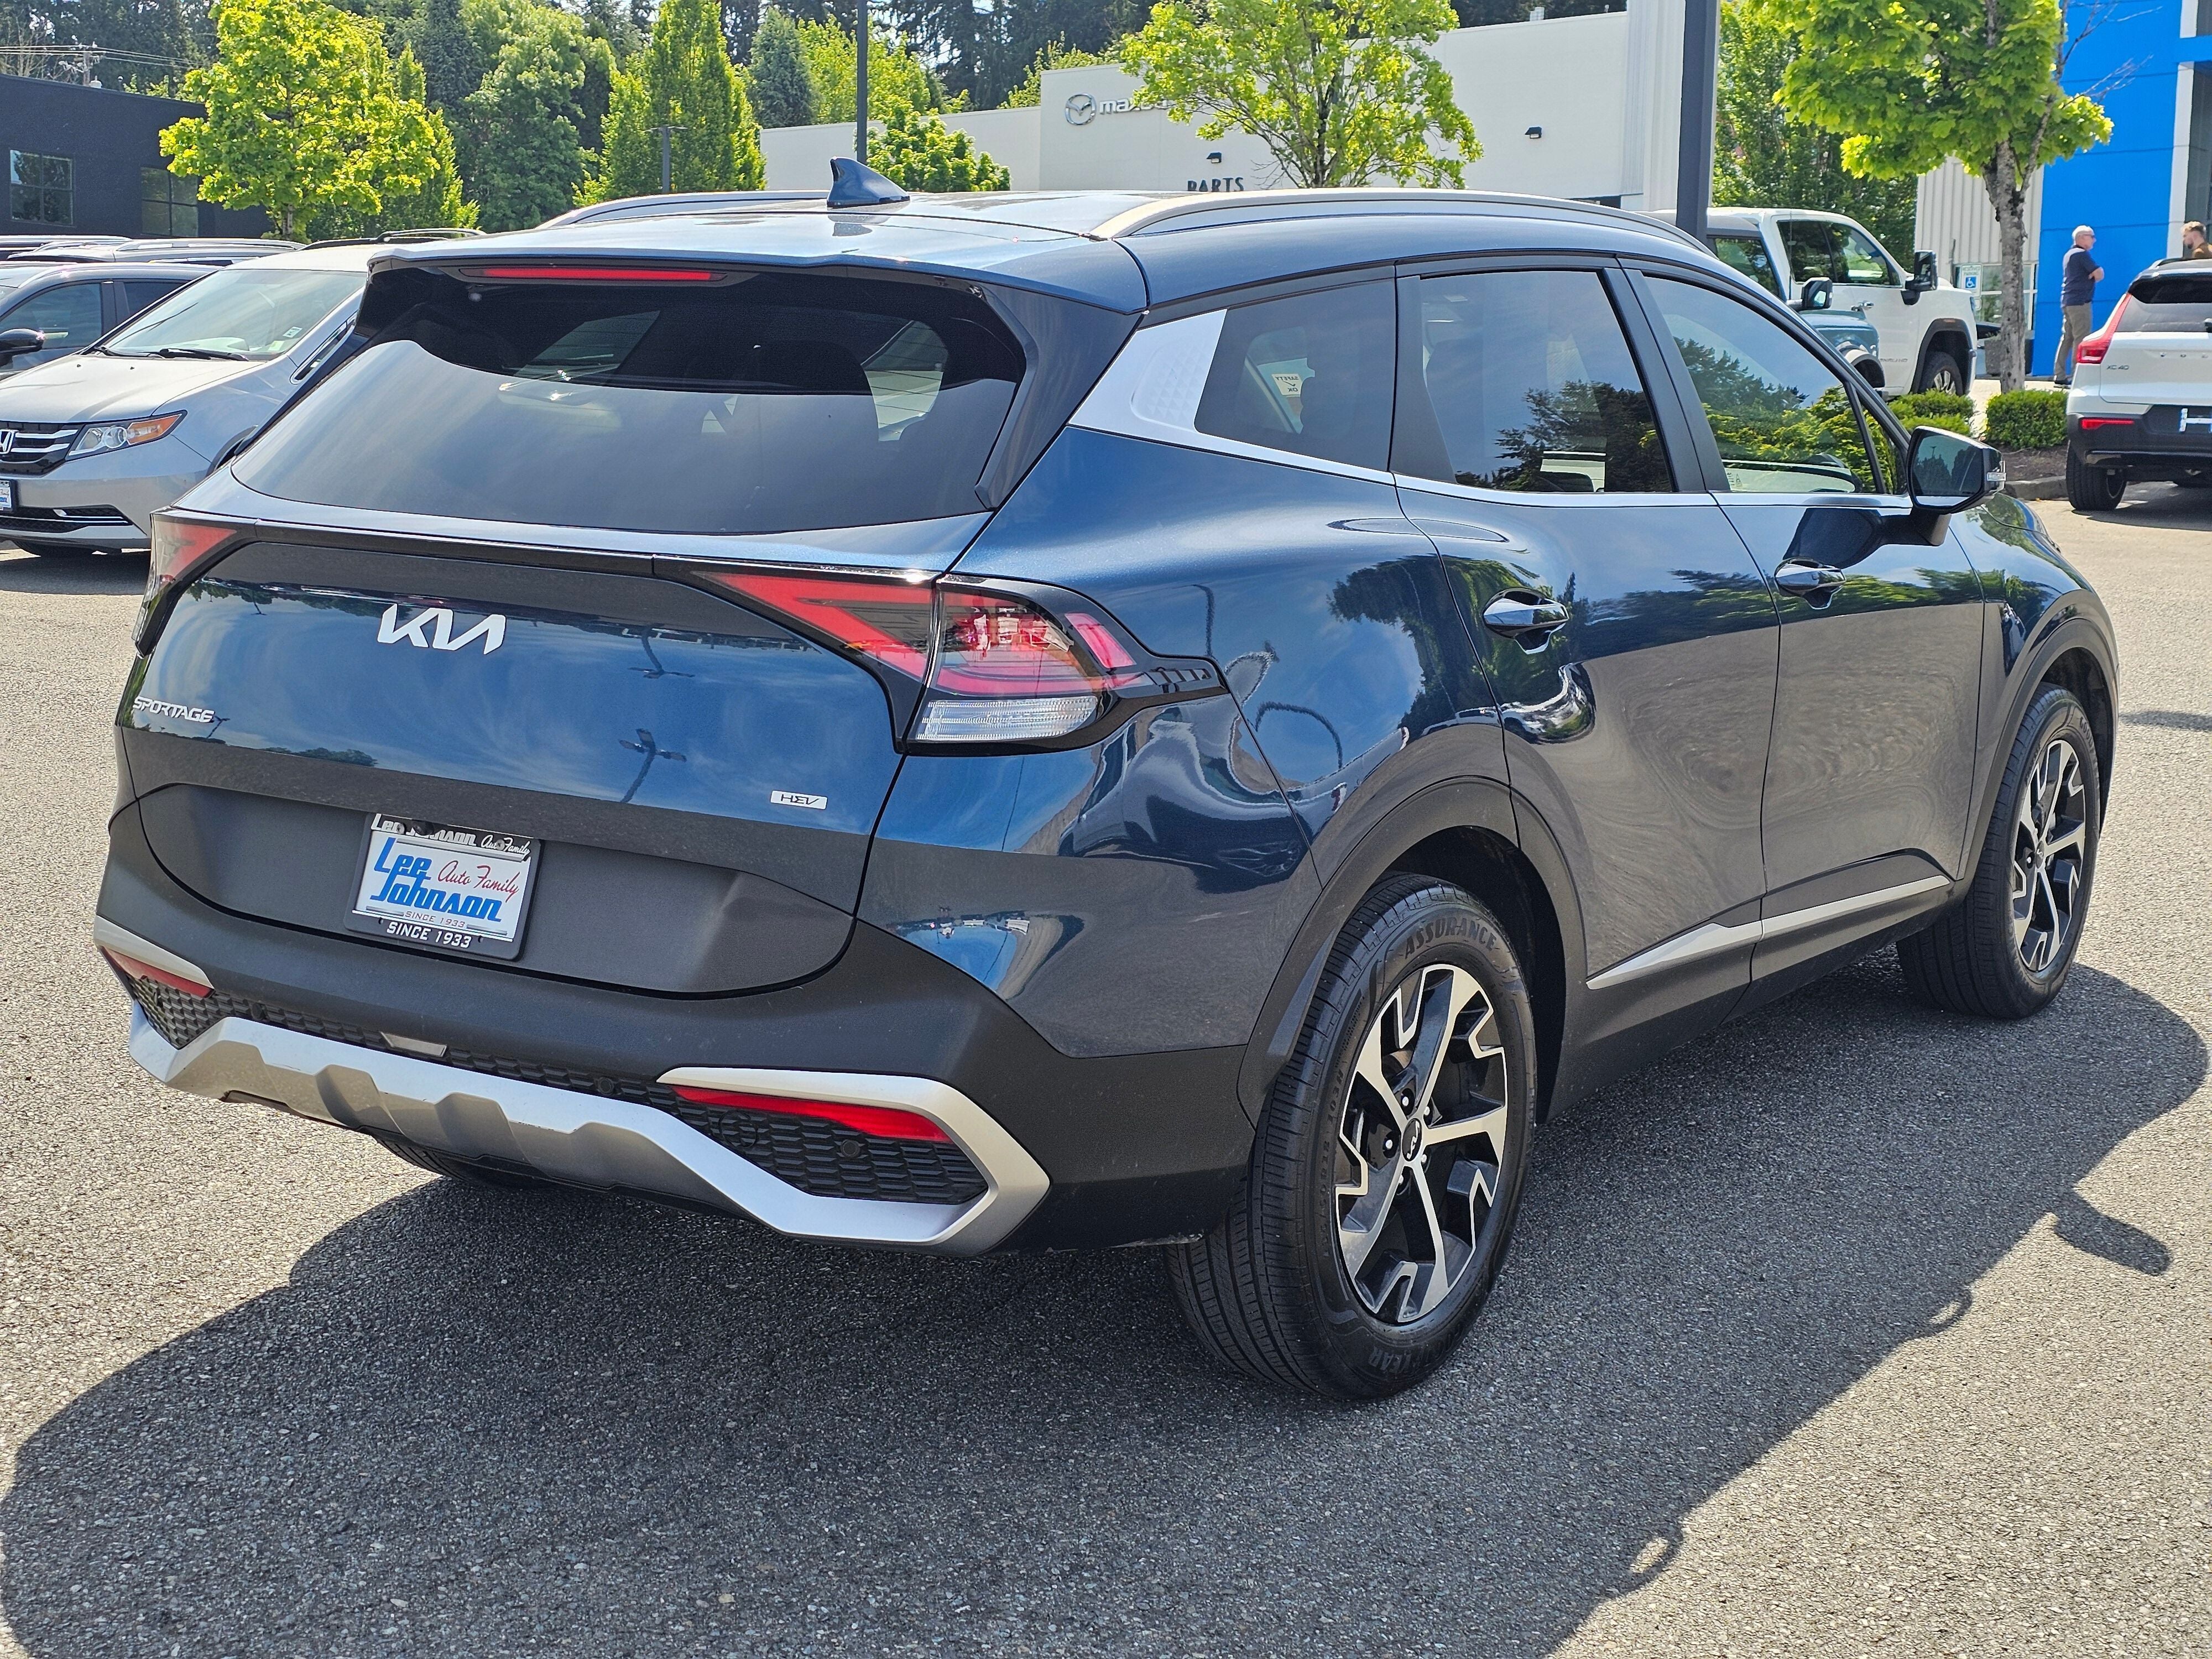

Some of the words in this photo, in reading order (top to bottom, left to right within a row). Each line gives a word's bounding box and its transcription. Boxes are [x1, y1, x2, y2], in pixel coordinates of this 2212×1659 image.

[1187, 177, 1244, 192] PARTS
[378, 604, 506, 655] KIA
[133, 696, 215, 723] SPORTAGE
[781, 794, 820, 805] HEV
[481, 834, 504, 850] Aut
[503, 837, 530, 860] Family
[374, 837, 432, 878] Lee
[437, 860, 471, 885] Auto
[473, 865, 520, 903] Family
[370, 871, 502, 922] Johnson
[405, 911, 436, 922] SINCE
[440, 917, 466, 928] 1933
[387, 921, 431, 941] SINCE
[435, 931, 472, 948] 1933
[1405, 917, 1497, 959] ASSURANCE
